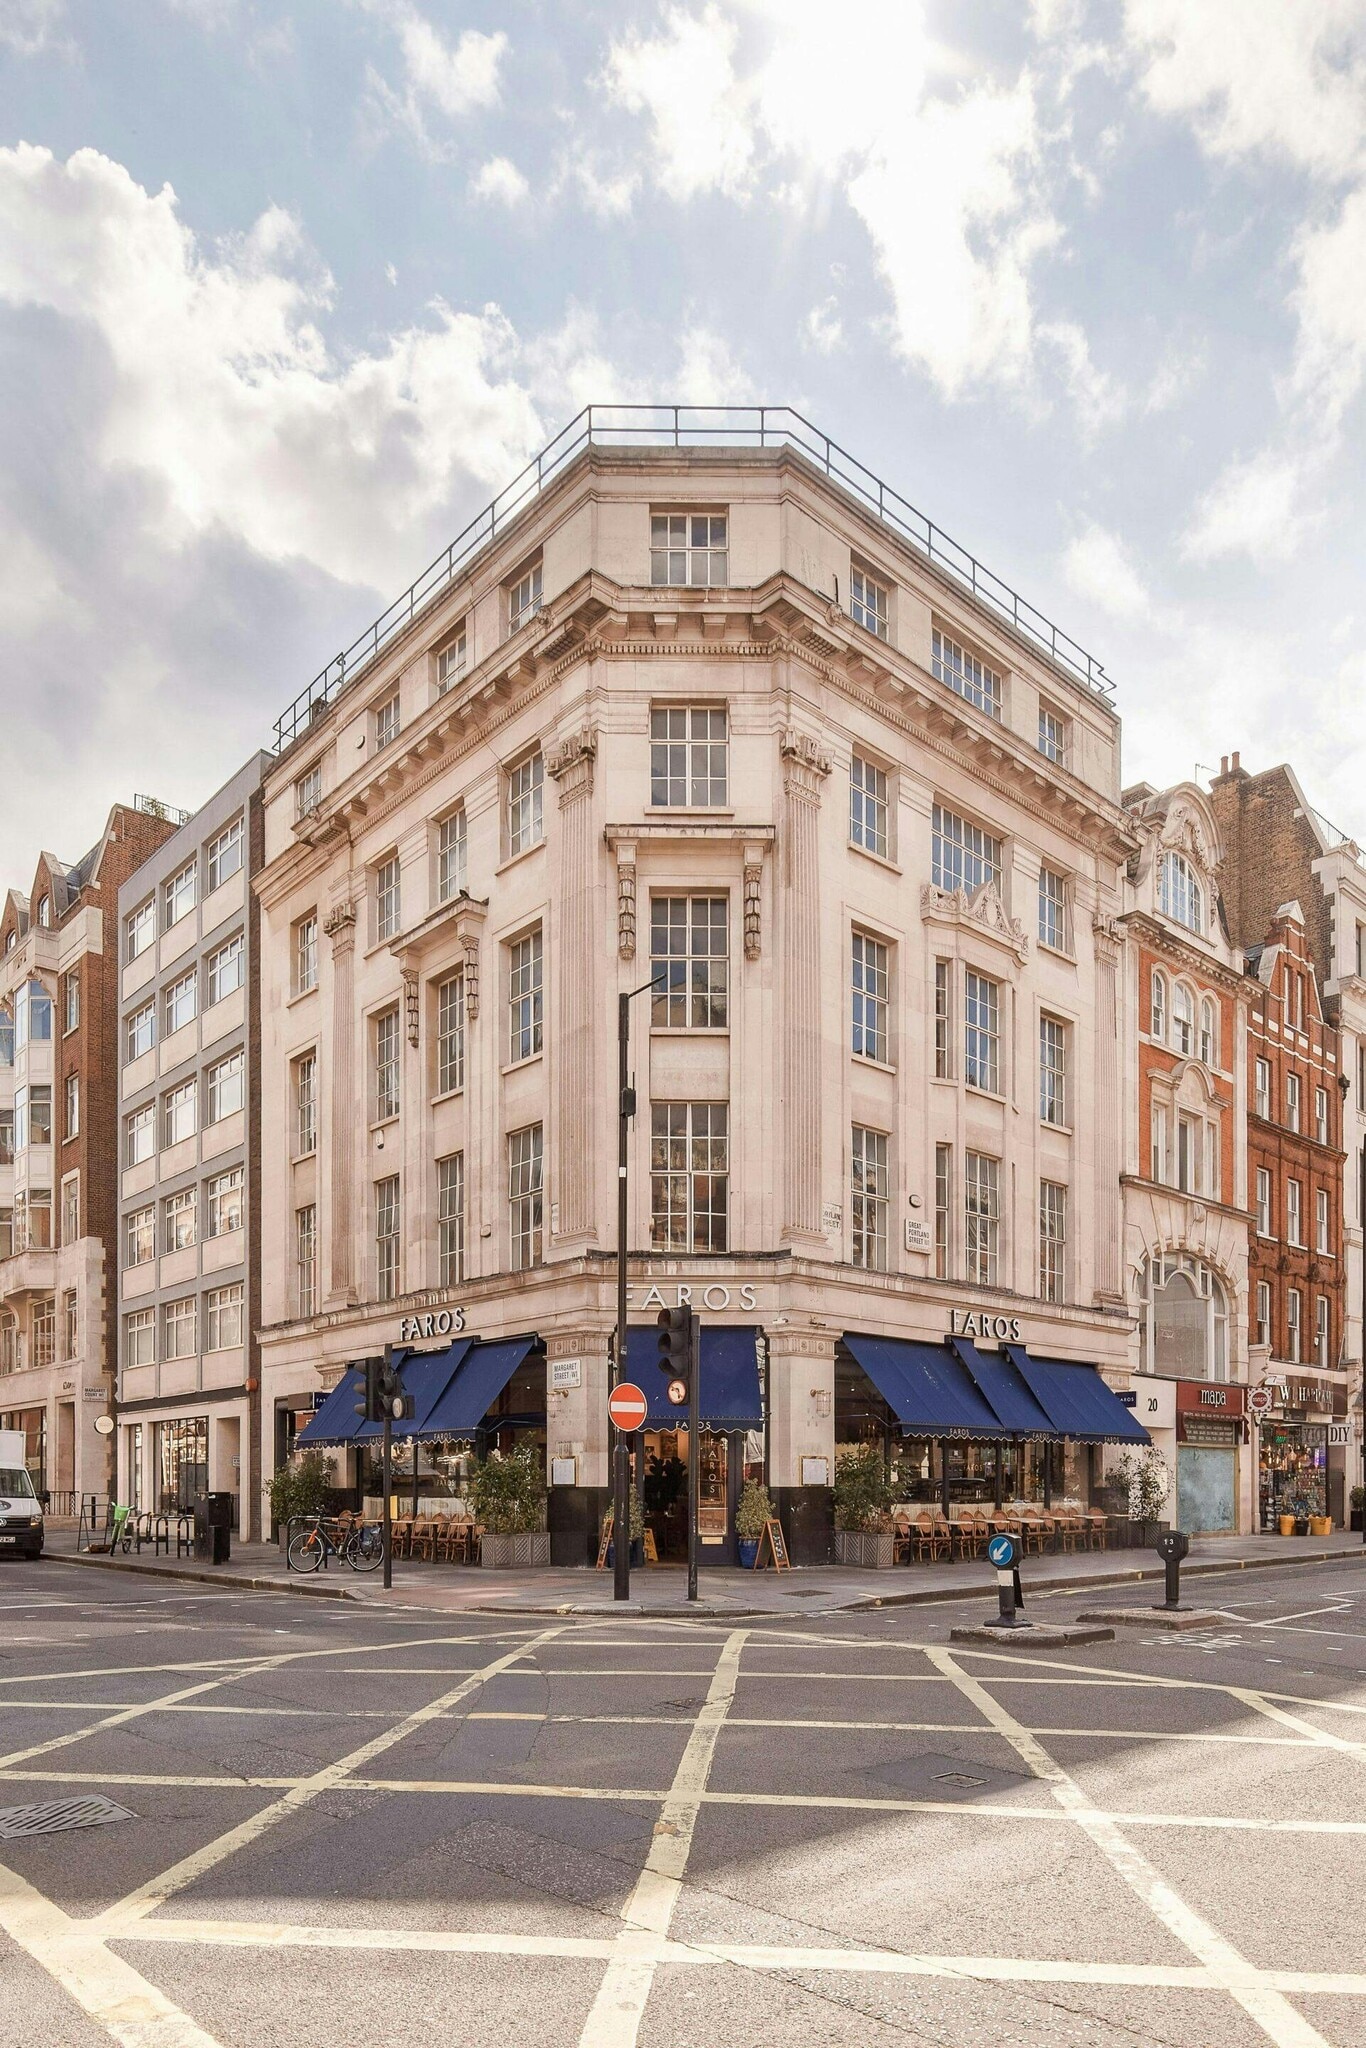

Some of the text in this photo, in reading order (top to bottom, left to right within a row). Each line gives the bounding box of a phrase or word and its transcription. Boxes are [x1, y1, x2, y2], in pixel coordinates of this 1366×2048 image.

[909, 1221, 921, 1230] GREAT
[909, 1229, 929, 1238] PORTLAND
[909, 1236, 923, 1245] STREET
[400, 1306, 466, 1341] FAROS
[950, 1309, 1021, 1341] FAROS
[554, 1363, 577, 1372] MARGARET
[554, 1372, 569, 1380] STREET
[1201, 1389, 1227, 1408] mapa
[1148, 1398, 1158, 1411] 20
[676, 1420, 711, 1429] FAOS
[949, 1428, 969, 1436] FAROS
[1330, 1427, 1350, 1442] DIY
[708, 1438, 717, 1494] FAROS
